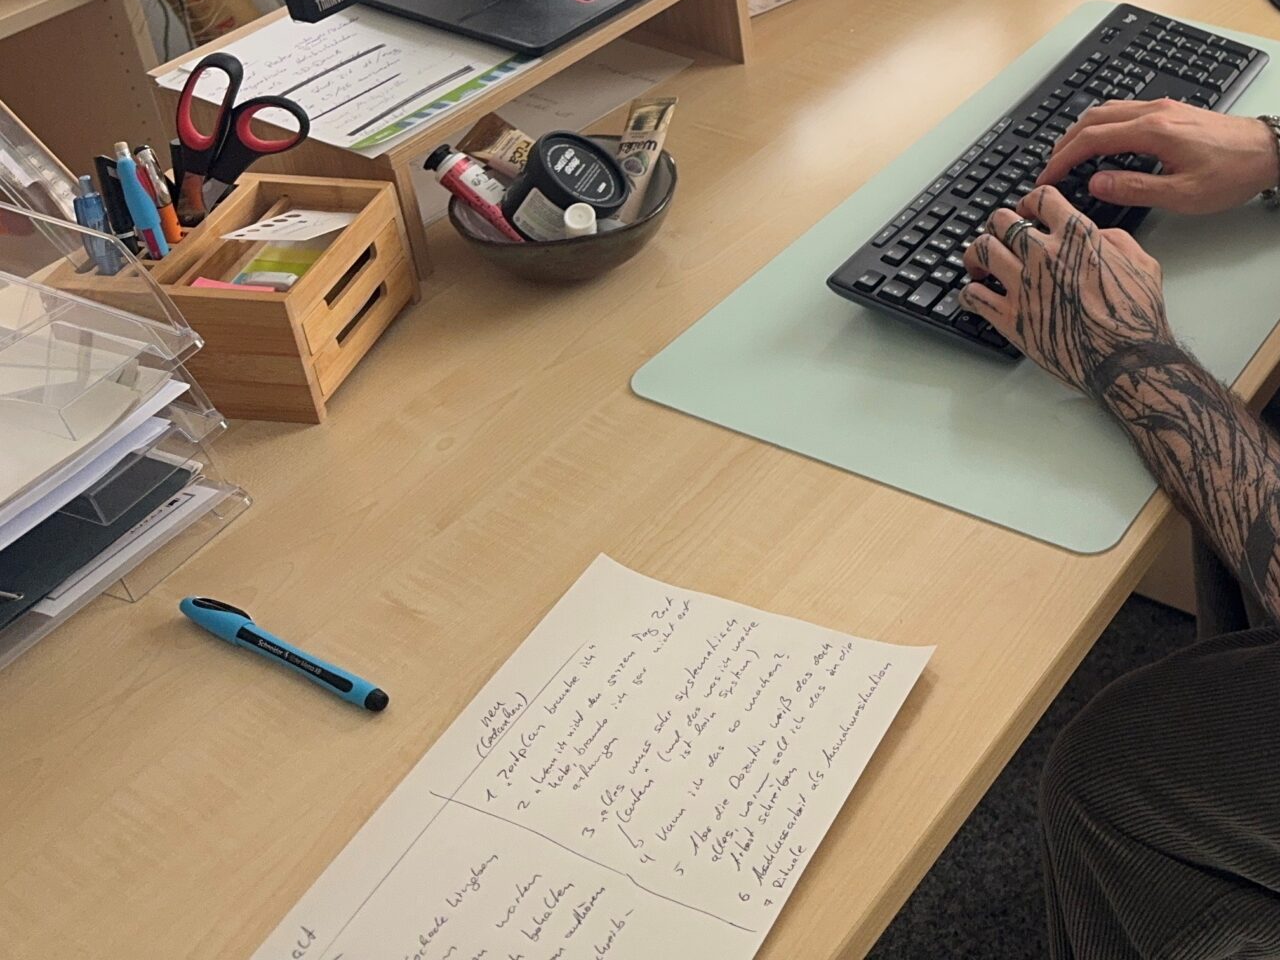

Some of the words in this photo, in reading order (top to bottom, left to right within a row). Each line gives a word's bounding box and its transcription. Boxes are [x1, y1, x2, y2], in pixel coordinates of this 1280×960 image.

[631, 627, 660, 644] Tag
[258, 639, 283, 656] Schneider
[480, 701, 506, 728] neu
[728, 719, 741, 734] so
